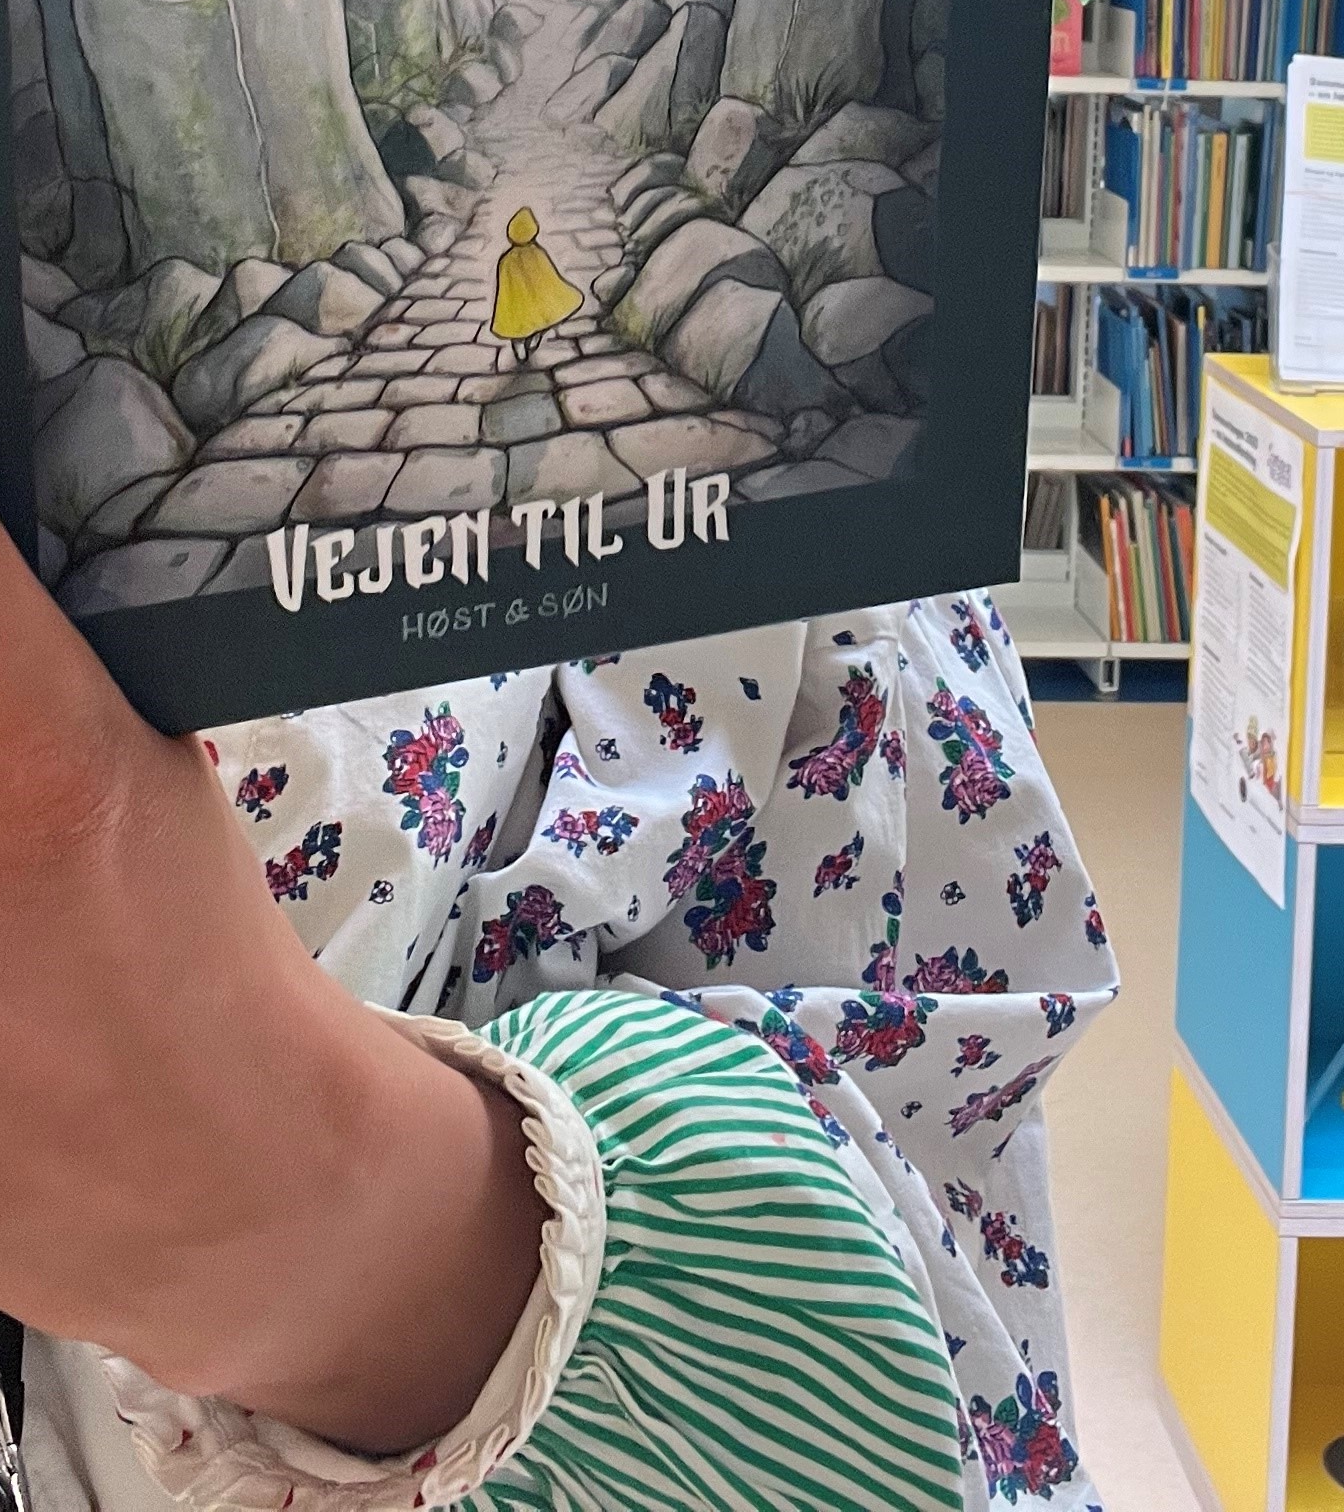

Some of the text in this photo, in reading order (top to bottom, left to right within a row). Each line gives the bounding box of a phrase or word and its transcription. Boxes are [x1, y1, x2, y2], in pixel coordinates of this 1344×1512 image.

[265, 466, 731, 613] VEJEN TIL UR
[402, 582, 609, 642] HØST & SØN
